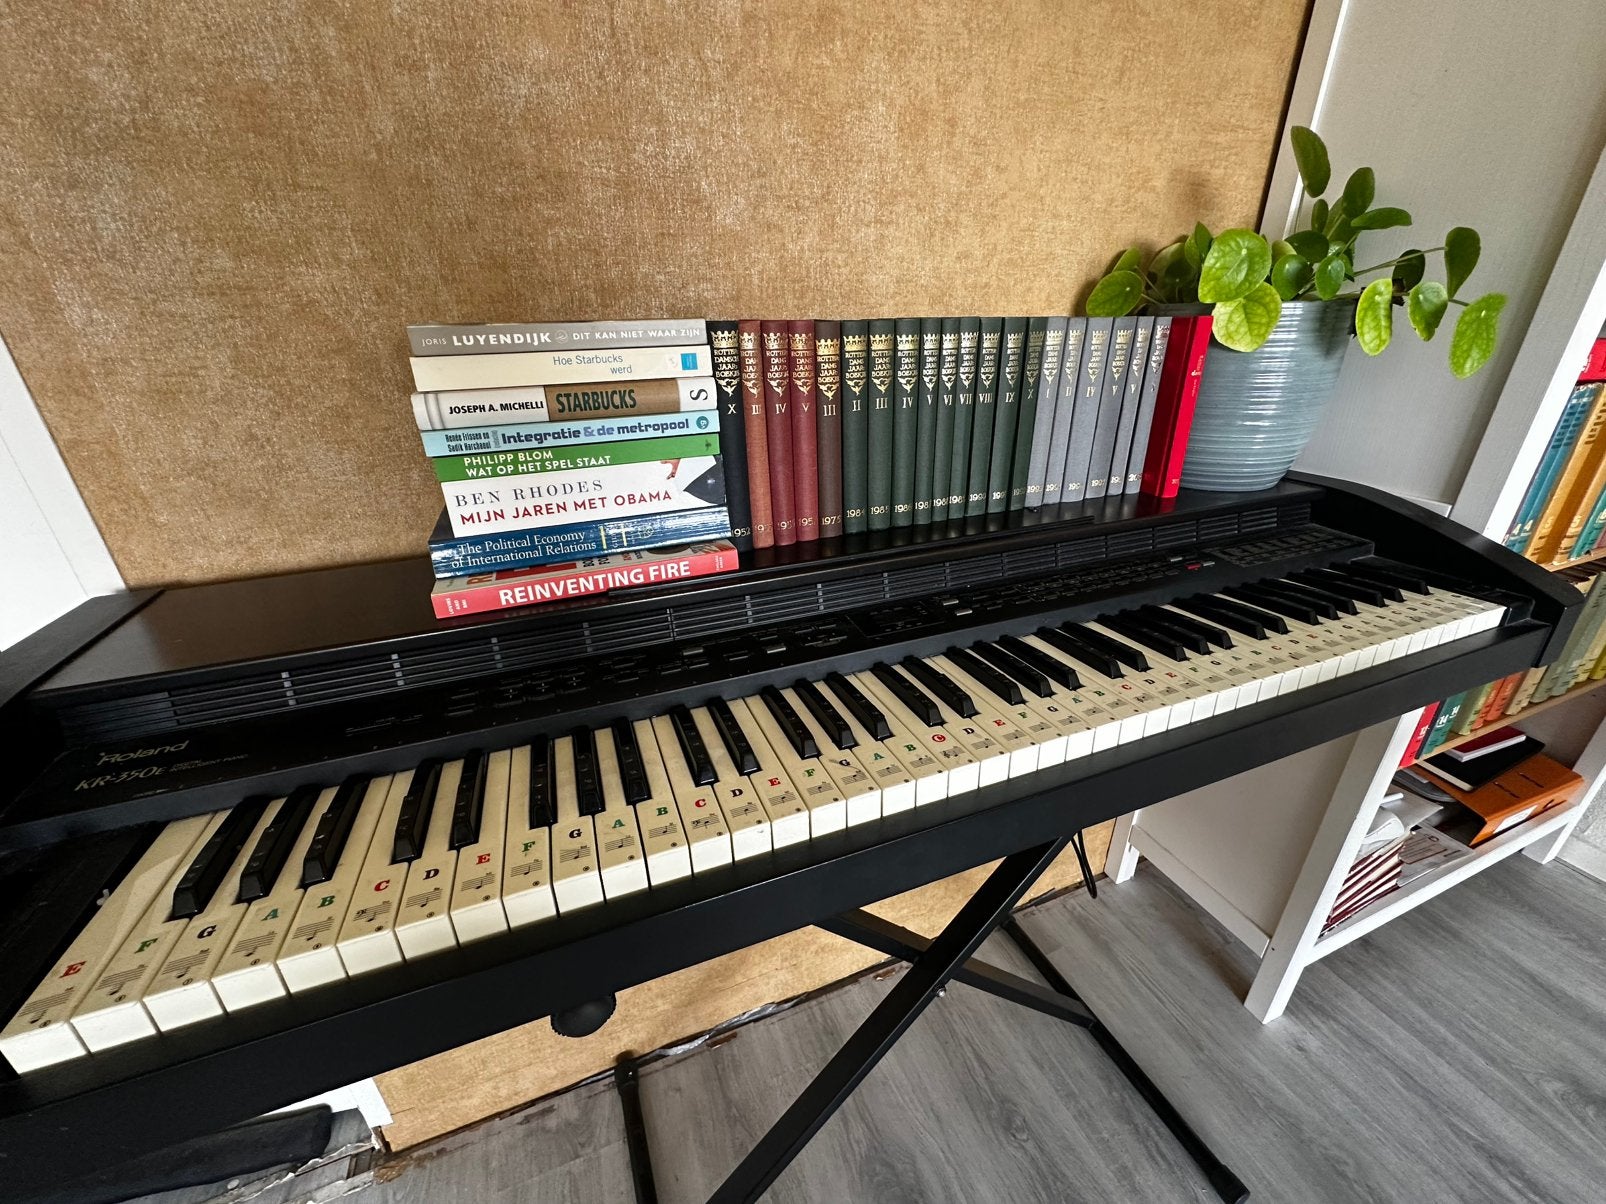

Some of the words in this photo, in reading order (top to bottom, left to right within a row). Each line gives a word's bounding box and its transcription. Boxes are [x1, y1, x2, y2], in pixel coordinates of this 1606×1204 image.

[421, 336, 447, 347] JORIS
[452, 332, 552, 346] LUYENDIJK
[572, 330, 590, 340] DIT
[595, 330, 616, 340] KAN
[621, 329, 644, 339] NIET
[647, 328, 678, 338] WAAR
[680, 328, 700, 338] ZIJN
[553, 355, 573, 366] Hoe
[576, 354, 623, 365] Starbucks
[610, 364, 632, 374] werd
[927, 394, 933, 406] V
[944, 394, 953, 406] VI
[960, 393, 972, 405] VII
[978, 392, 993, 404] VIII
[1005, 392, 1016, 402] IX
[1027, 388, 1034, 400] X
[555, 388, 637, 414] STARBUCKS
[802, 402, 810, 412] V
[852, 400, 861, 412] II
[875, 398, 888, 410] III
[902, 396, 914, 409] IV
[448, 404, 486, 415] JOSEPH
[488, 402, 498, 413] A.
[500, 400, 544, 412] MICHELLI
[728, 404, 736, 415] X
[776, 402, 786, 414] IV
[823, 404, 836, 416] III
[502, 429, 582, 446] Integratie
[584, 428, 596, 438] &
[597, 425, 614, 436] de
[617, 418, 690, 438] metropool
[464, 452, 514, 466] PHILIPP
[518, 450, 554, 462] BLOM
[466, 466, 494, 478] WAT
[497, 464, 514, 476] OP
[518, 462, 542, 474] HET
[544, 458, 574, 471] SPEL
[576, 455, 611, 468] STAAT
[454, 490, 500, 507] BEN
[514, 480, 604, 500] RHODES
[460, 508, 508, 526] MIJN
[512, 502, 567, 521] JAREN
[572, 496, 606, 514] MET
[614, 490, 672, 507] OBAMA
[458, 542, 482, 556] The
[485, 536, 532, 552] Political
[534, 530, 586, 550] Economy
[452, 554, 466, 569] of
[468, 546, 544, 565] International
[546, 540, 597, 556] Relations
[498, 562, 644, 606] REINVENTING
[648, 560, 691, 580] FIRE
[1017, 712, 1028, 720] F
[933, 734, 944, 742] C
[96, 740, 190, 766] Roland
[904, 744, 917, 752] B
[872, 752, 885, 760] A
[838, 758, 850, 767] G
[804, 768, 816, 777] F
[768, 777, 781, 786] E
[730, 788, 744, 798] D
[694, 798, 707, 808] C
[656, 806, 668, 816] B
[612, 818, 626, 829] A
[568, 828, 583, 838] G
[522, 840, 536, 853] F
[476, 853, 492, 865] E
[422, 868, 440, 880] D
[374, 880, 390, 892] C
[317, 895, 336, 908] B
[260, 908, 280, 922] A
[196, 925, 217, 940] G
[134, 938, 158, 954] F
[60, 960, 86, 978] E
